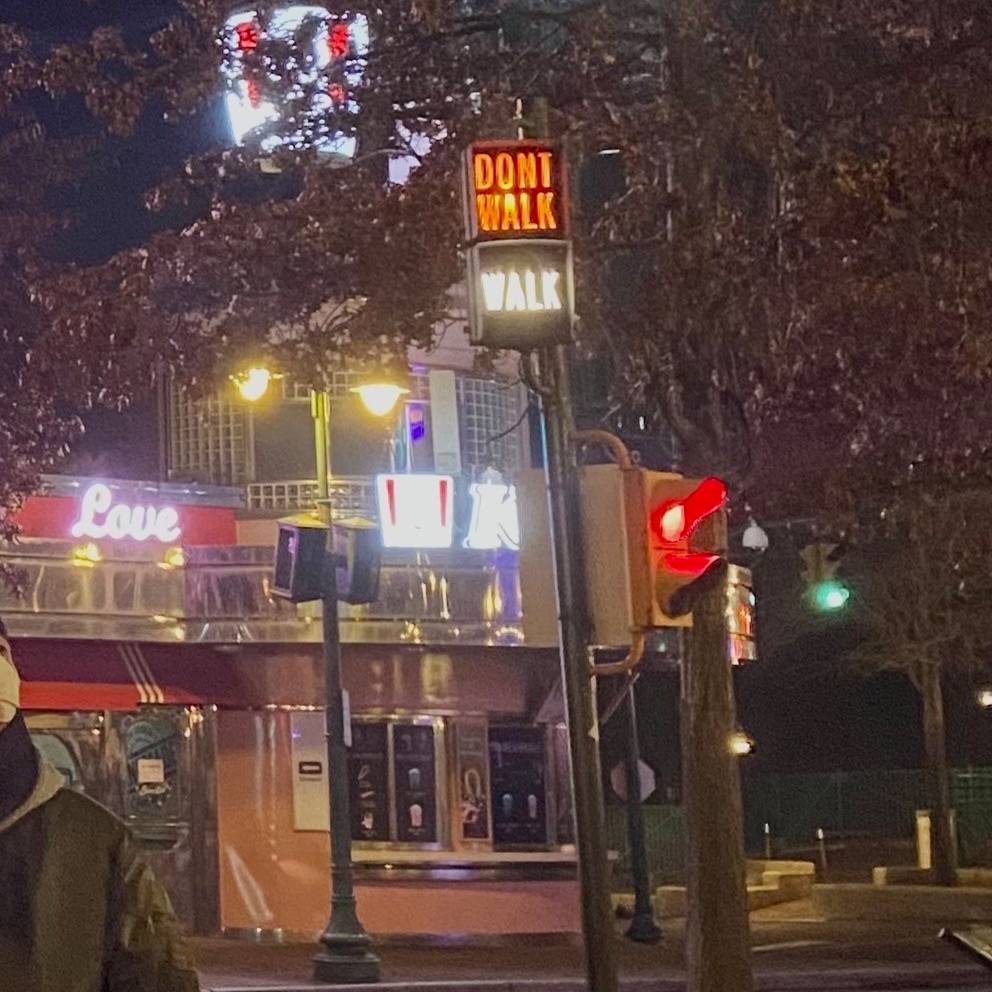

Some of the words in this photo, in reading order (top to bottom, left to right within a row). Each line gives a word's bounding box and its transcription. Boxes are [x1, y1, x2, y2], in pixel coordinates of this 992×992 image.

[474, 151, 553, 190] DONT
[476, 192, 557, 231] WALK
[481, 269, 562, 311] WALK
[71, 483, 182, 542] Love
